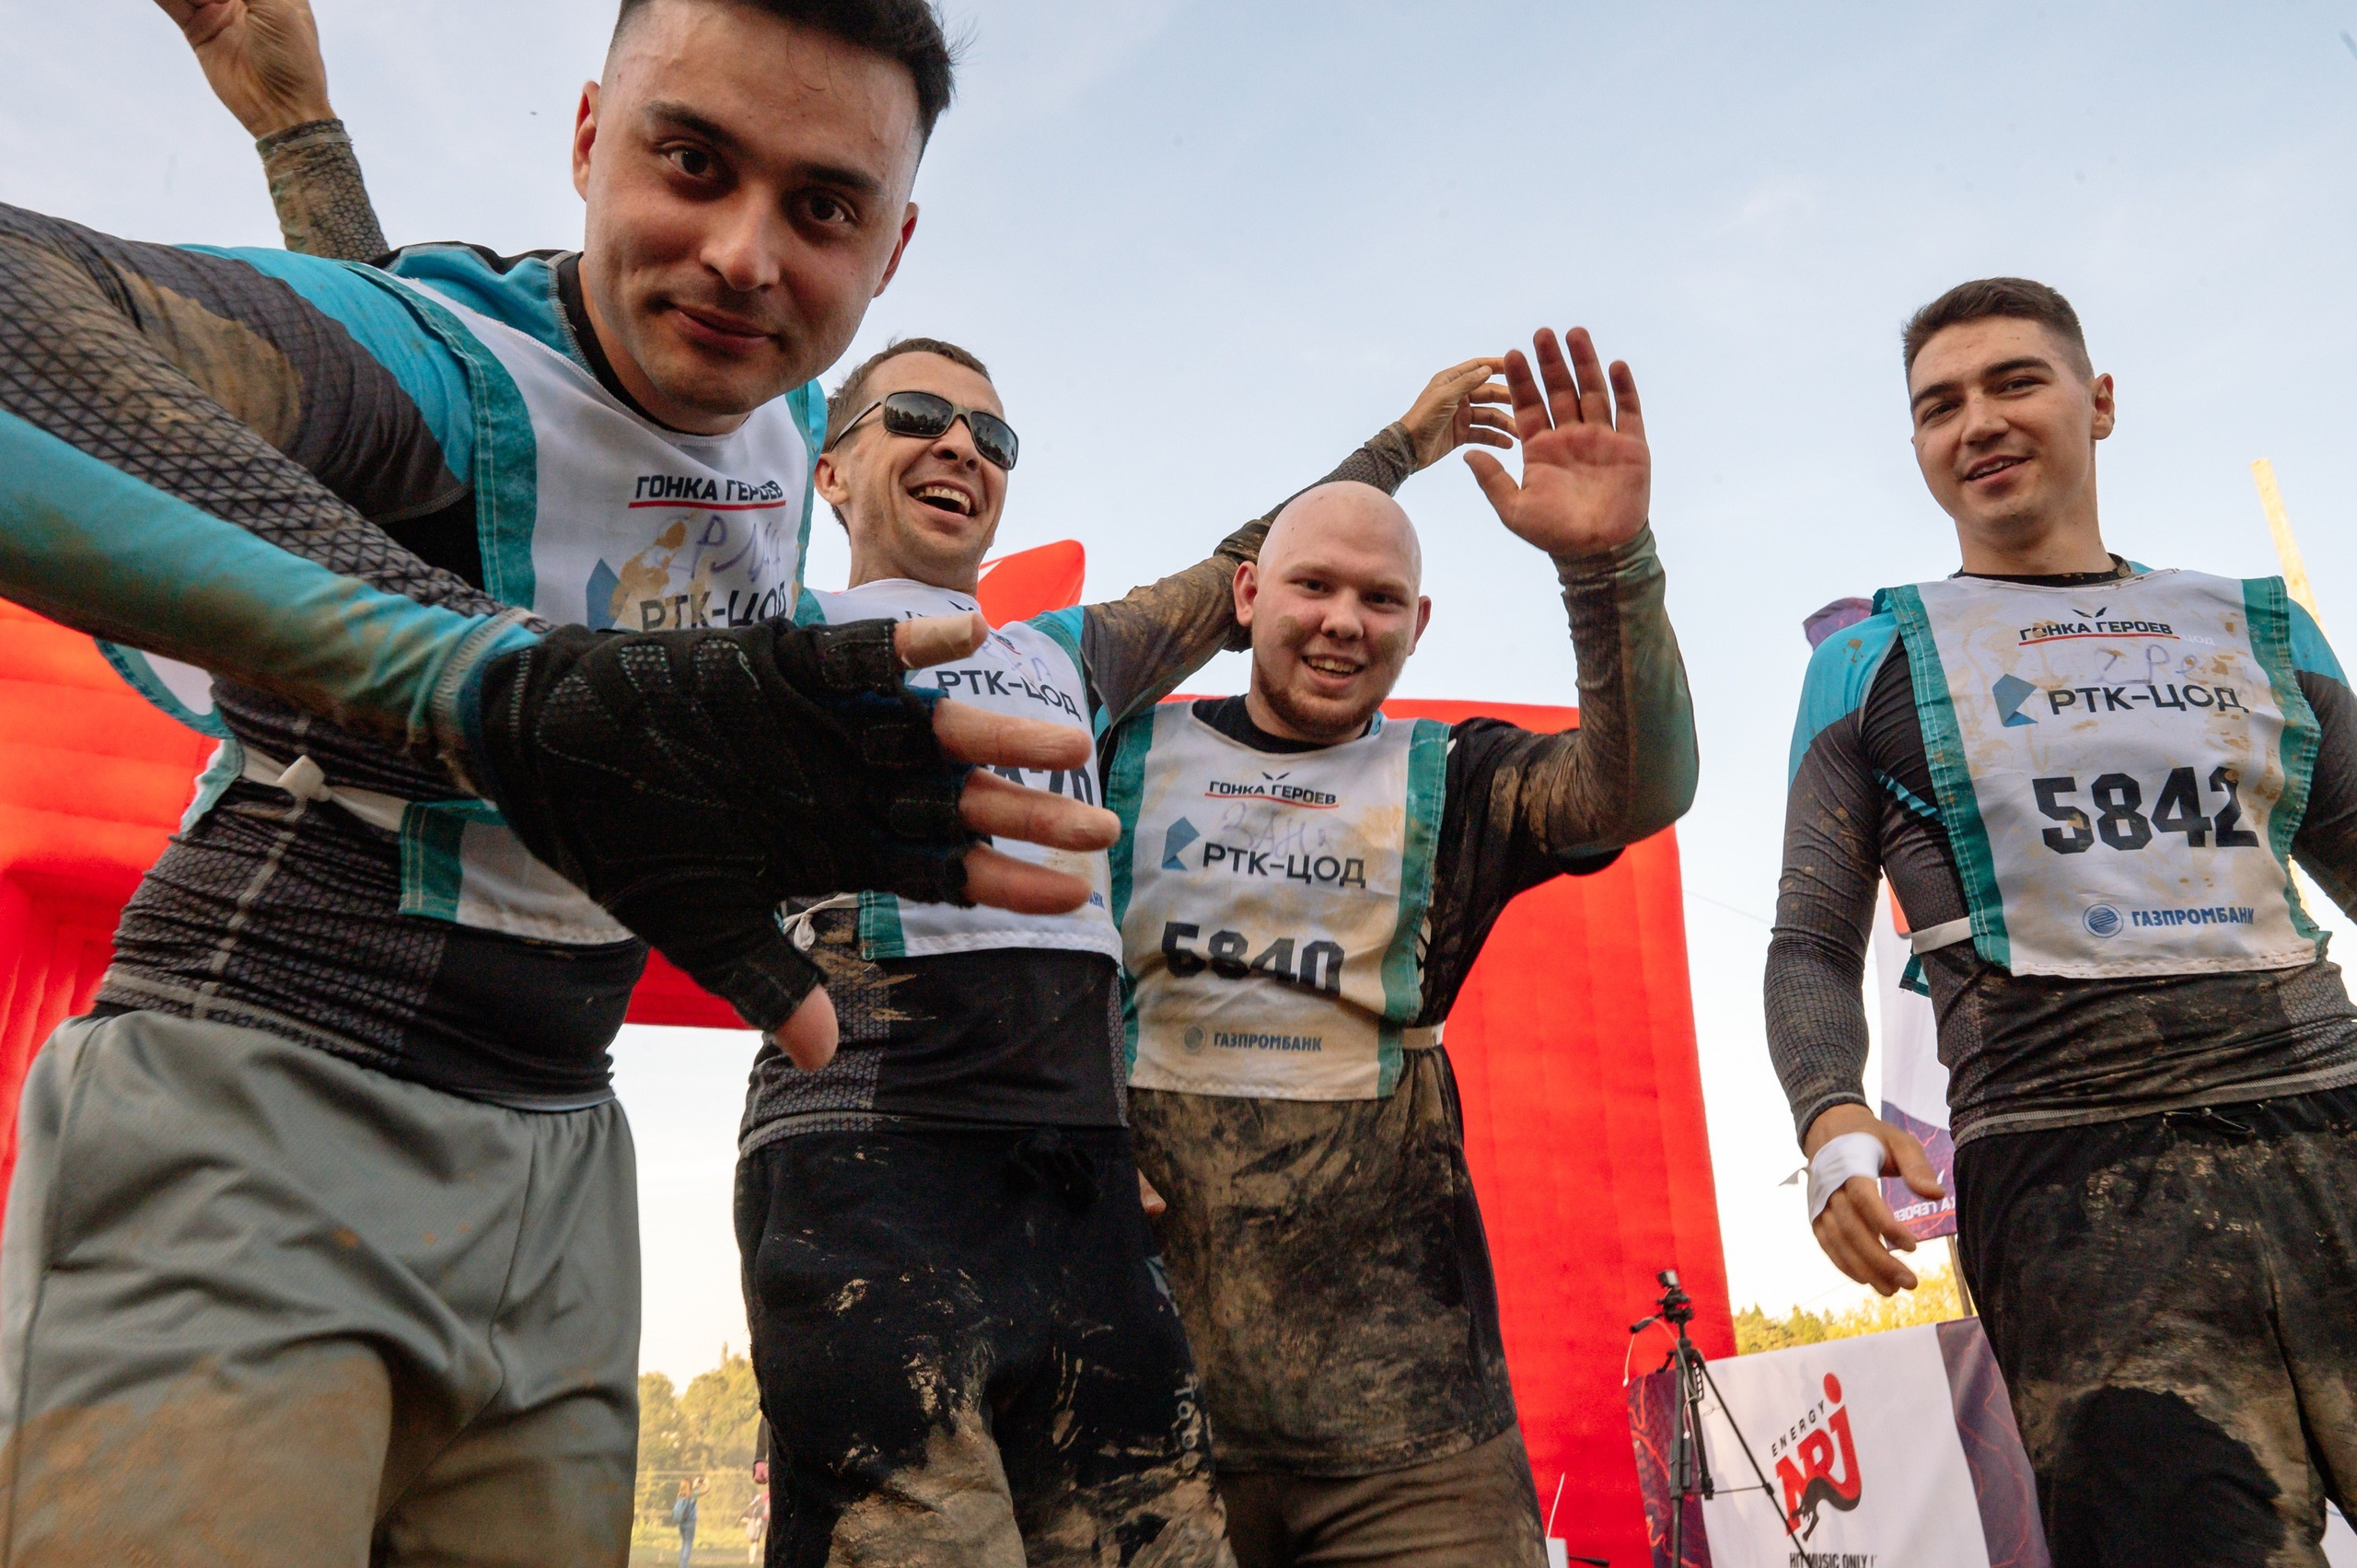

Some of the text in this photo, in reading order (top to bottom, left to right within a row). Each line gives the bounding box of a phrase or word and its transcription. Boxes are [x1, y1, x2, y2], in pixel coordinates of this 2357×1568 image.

[635, 475, 784, 501] ГОНКА ГЕРОЕВ
[2019, 621, 2174, 641] ГОНКА ГЕРОЕВ
[935, 669, 1083, 723] РТК-ЦОД
[2048, 683, 2250, 715] РТК-ЦОД
[1209, 781, 1337, 805] ГОНКА ГЕРОЕВ
[2031, 765, 2259, 855] 5842
[1202, 842, 1366, 889] РТК-ЦОД
[2131, 906, 2255, 927] ГАЗПРОМБАНК
[1162, 922, 1345, 998] 5840
[1213, 1031, 1322, 1052] ГАЗПРОМБАНК
[1771, 1400, 1826, 1459] ENERGY
[1841, 1553, 1868, 1568] ONLY
